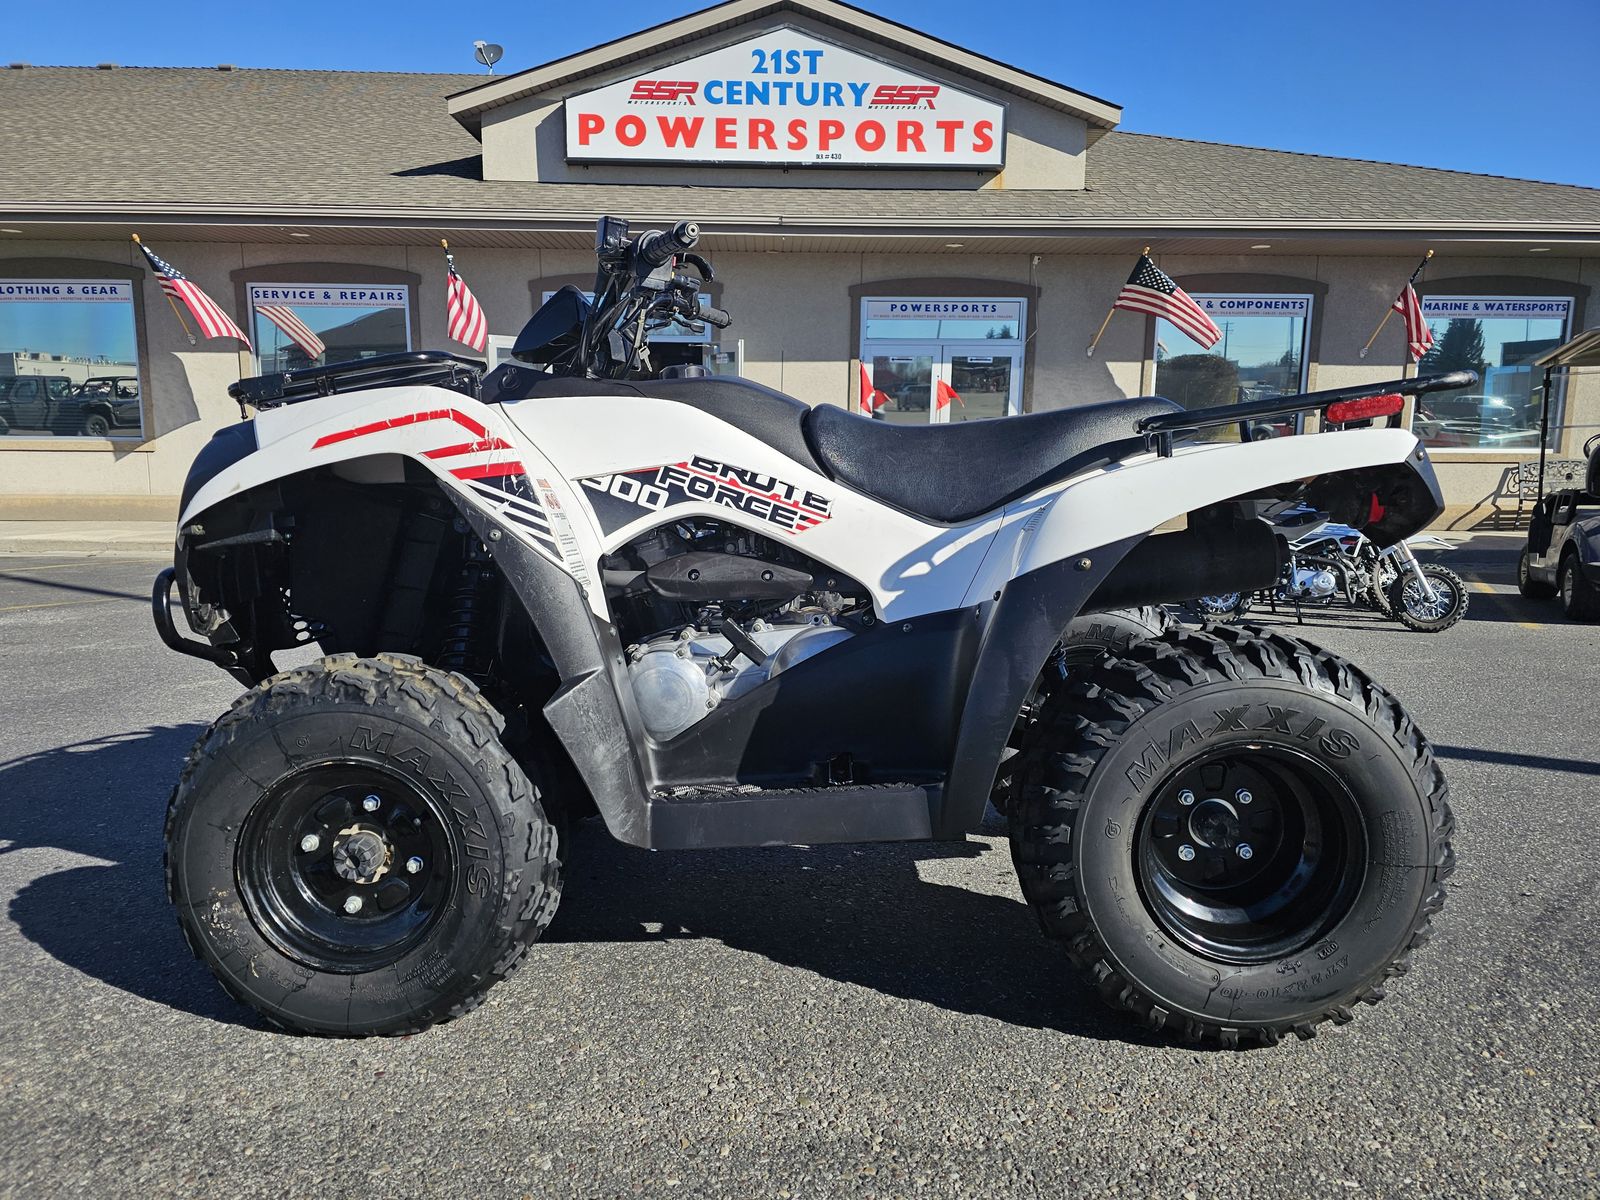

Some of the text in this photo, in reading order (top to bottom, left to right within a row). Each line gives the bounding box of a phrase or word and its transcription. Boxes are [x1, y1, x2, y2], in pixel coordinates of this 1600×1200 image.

[751, 48, 825, 75] 21ST
[630, 80, 699, 106] SSR
[703, 80, 869, 106] CENTURY
[870, 85, 940, 109] SSR
[578, 113, 994, 153] POWERSPORTS
[66, 286, 75, 295] &
[81, 286, 119, 295] GEAR
[254, 290, 404, 301] SERVICE & REPAIRS
[890, 303, 997, 313] POWERSPORTS
[1205, 300, 1214, 309] &
[1219, 300, 1305, 310] COMPONENTS
[1423, 302, 1567, 312] MARINE & WATERSPORTS
[690, 454, 833, 513] BRUTE
[655, 464, 801, 531] FORCE
[1124, 703, 1361, 793] MAXXIS
[350, 725, 492, 899] MAXXIS
